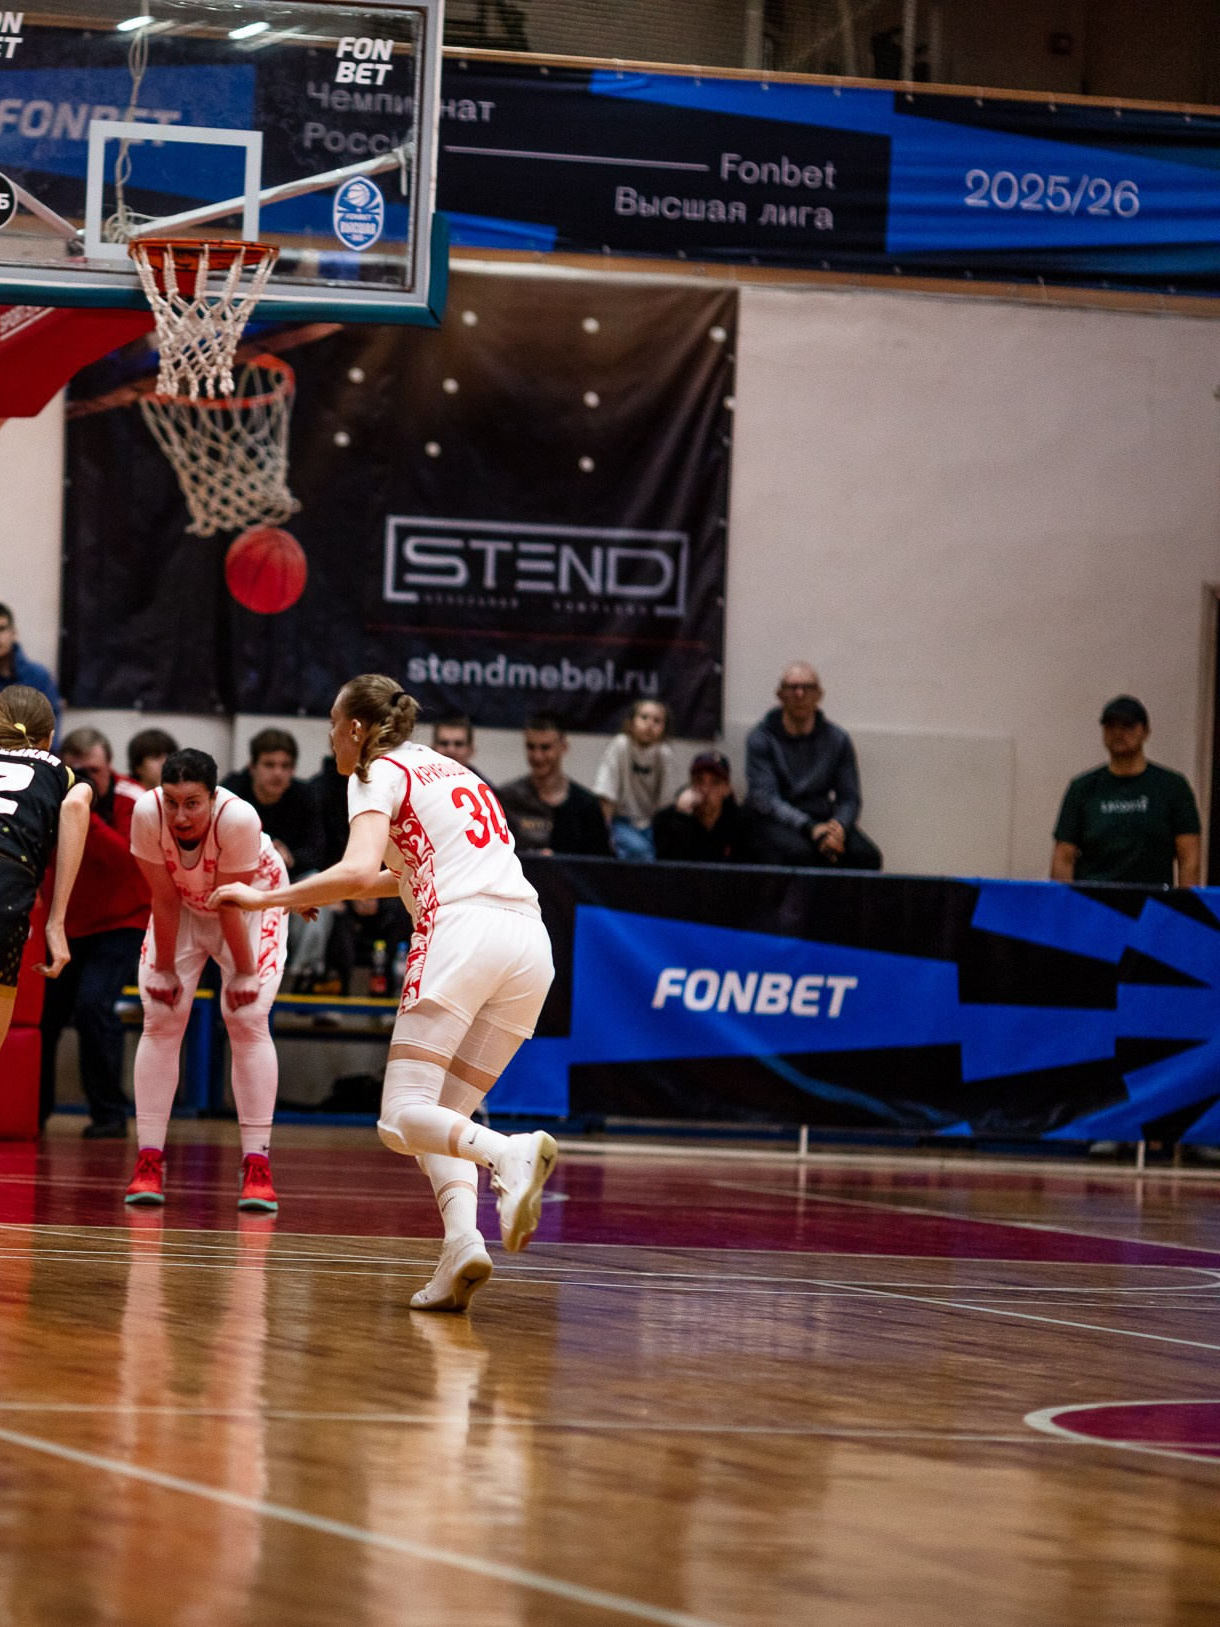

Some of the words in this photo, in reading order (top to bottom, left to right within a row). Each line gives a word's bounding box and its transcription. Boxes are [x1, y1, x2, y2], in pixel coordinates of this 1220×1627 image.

[336, 37, 394, 61] FON
[335, 61, 393, 86] BET
[720, 152, 837, 190] Fonbet
[964, 168, 1141, 218] 2025/26
[614, 186, 748, 224] Высшая
[758, 202, 835, 231] лига
[402, 536, 675, 598] STEND
[407, 653, 659, 694] stendmebel.ru
[451, 783, 510, 848] 30
[651, 967, 859, 1018] FONBET
